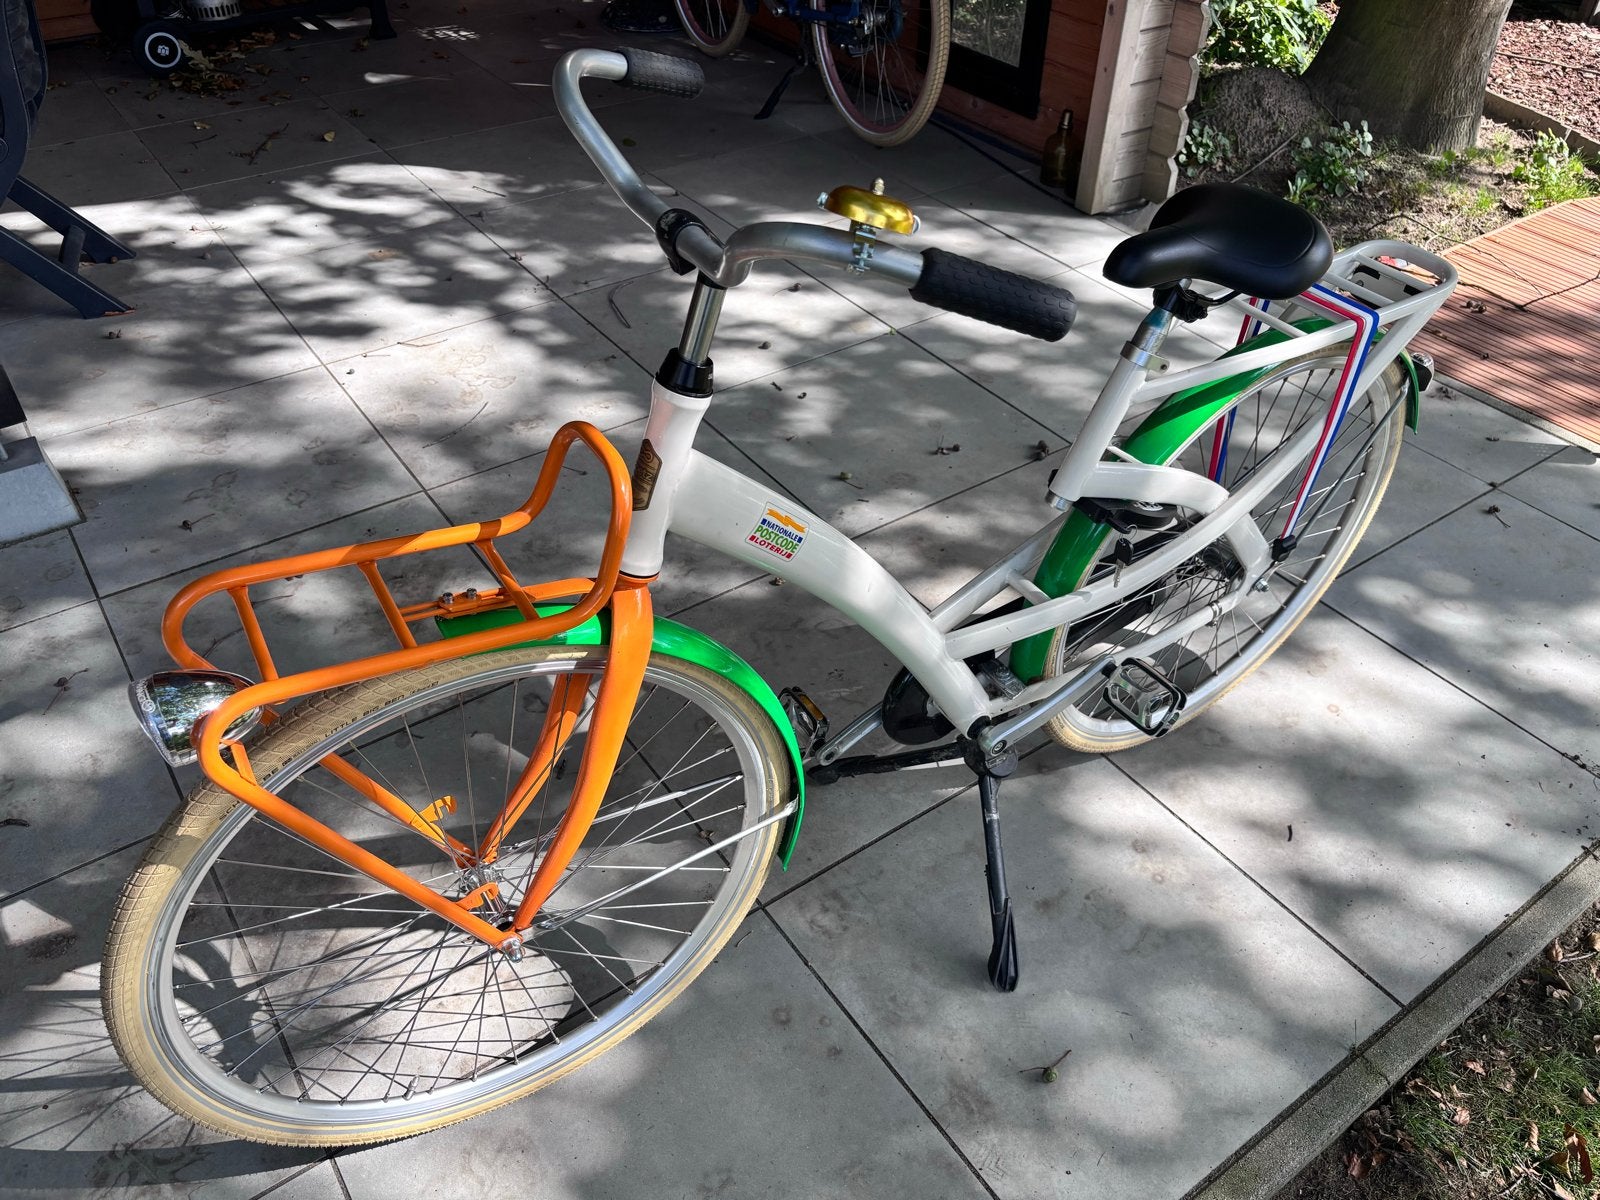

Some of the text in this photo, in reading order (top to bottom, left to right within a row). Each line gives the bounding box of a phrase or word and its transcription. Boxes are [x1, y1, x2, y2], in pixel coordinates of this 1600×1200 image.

[754, 525, 800, 553] POSTCODE
[765, 520, 799, 542] NATIONALE
[754, 537, 788, 557] LOTERIJ
[325, 716, 358, 738] LITTLE
